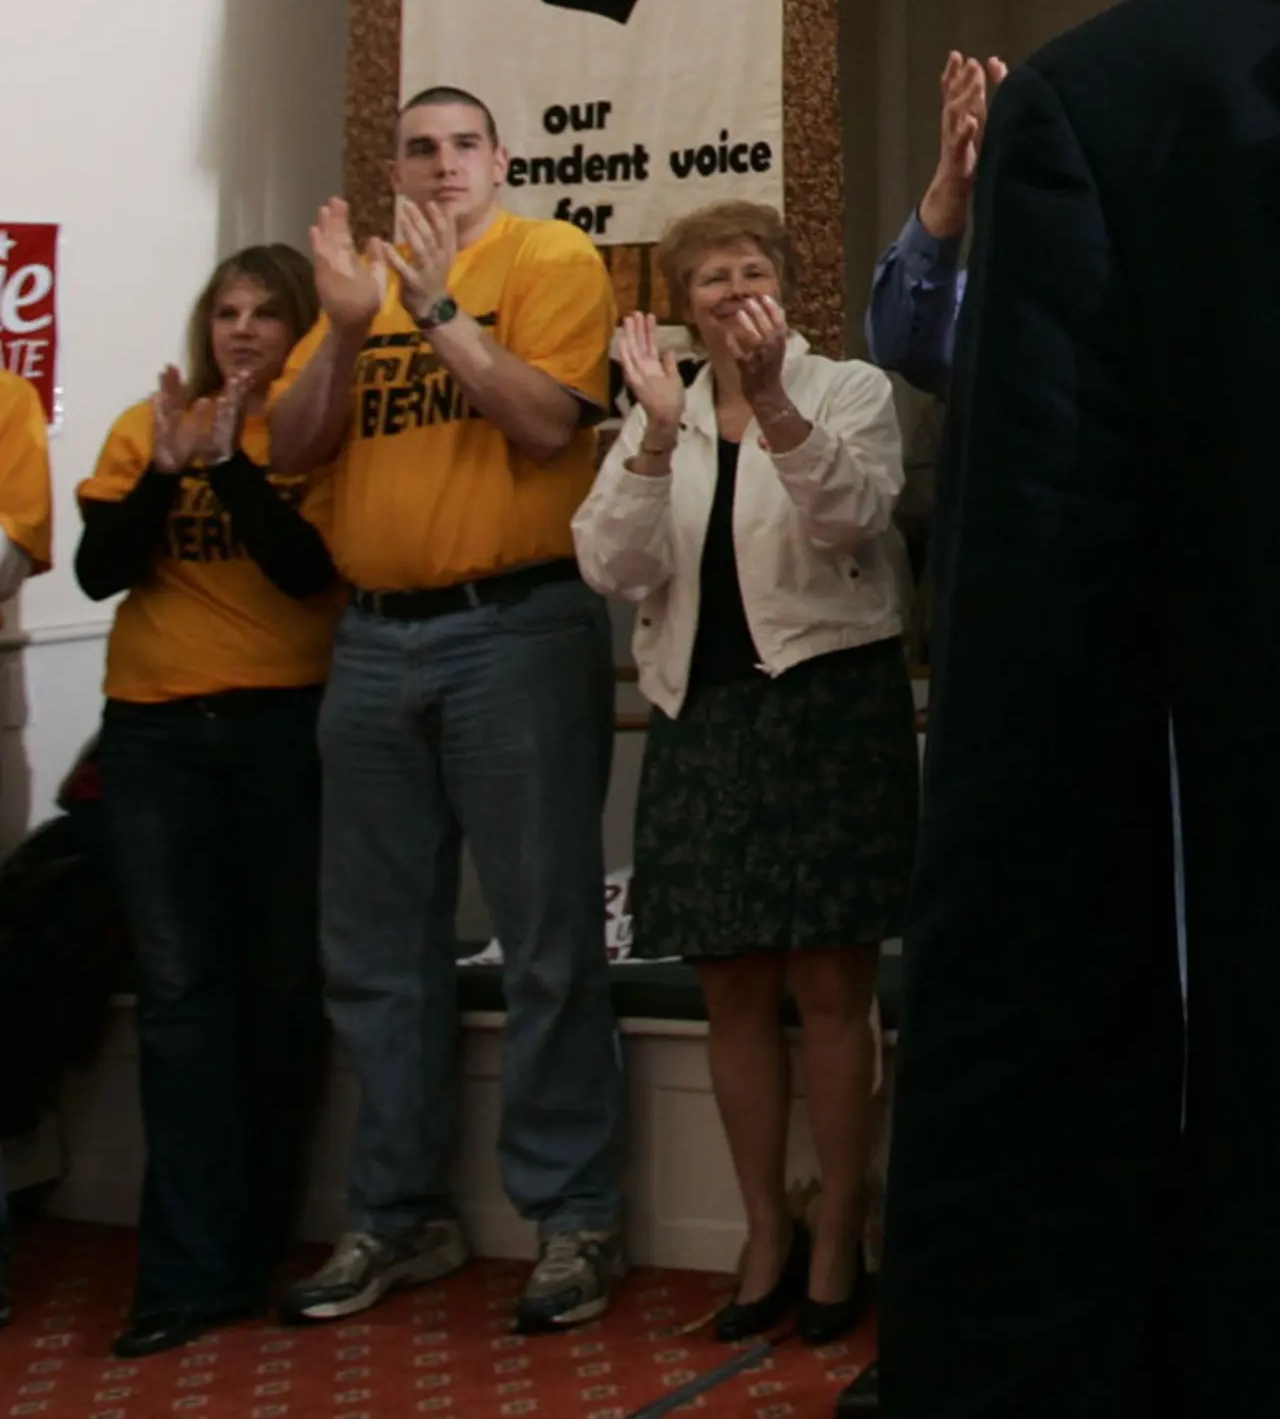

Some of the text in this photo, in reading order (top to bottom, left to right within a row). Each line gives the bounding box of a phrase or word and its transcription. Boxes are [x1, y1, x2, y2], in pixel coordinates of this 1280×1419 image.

[543, 100, 612, 135] our
[506, 129, 772, 187] endent voice
[0, 262, 54, 334] e
[0, 339, 49, 379] TE
